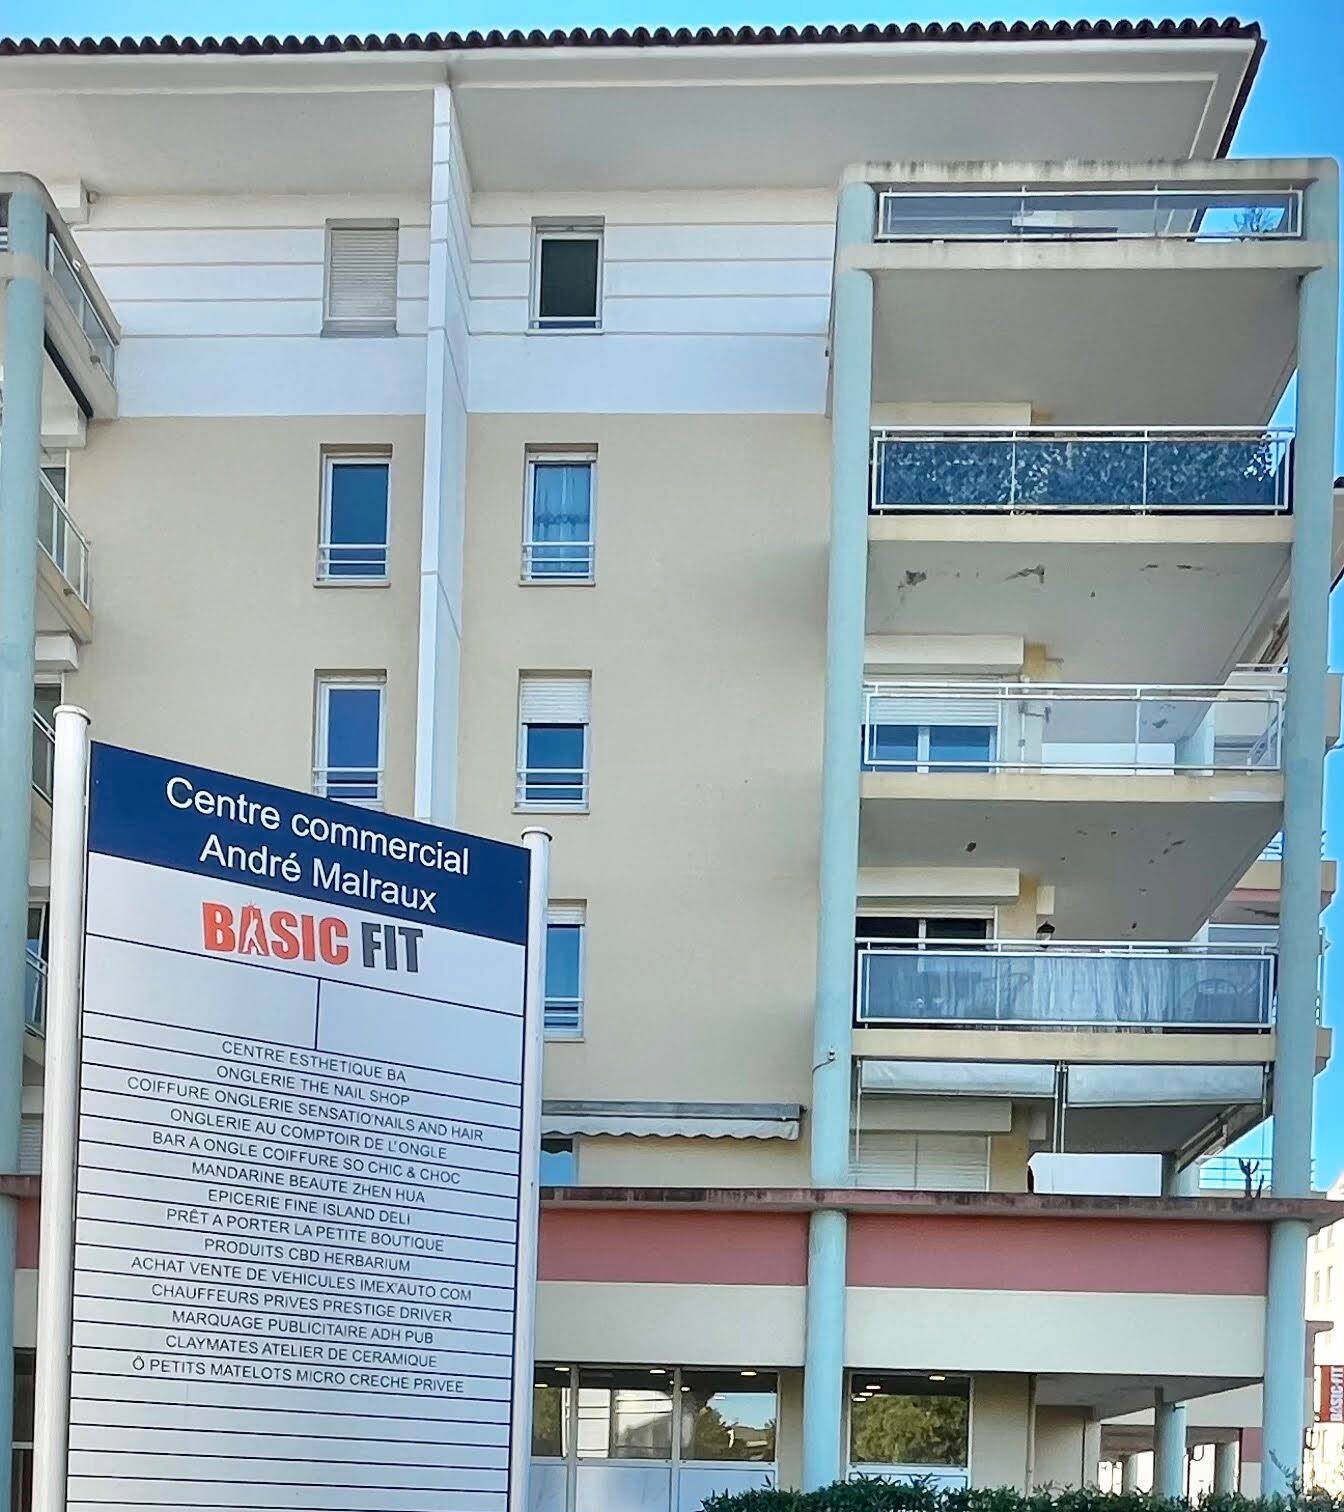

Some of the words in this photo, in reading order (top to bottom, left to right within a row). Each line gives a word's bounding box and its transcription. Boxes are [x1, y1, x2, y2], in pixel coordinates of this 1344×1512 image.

[166, 776, 280, 830] Centre
[292, 813, 470, 875] commercial
[199, 834, 302, 882] André
[312, 859, 437, 913] Malraux
[202, 902, 349, 966] BASIC
[361, 921, 424, 974] FIT
[221, 1040, 285, 1063] CENTRE
[289, 1052, 382, 1079] ESTHETIQUE
[387, 1068, 406, 1083] BA
[216, 1065, 295, 1089] ONGLERIE
[299, 1078, 329, 1095] THE
[333, 1083, 365, 1100] NAIL
[369, 1089, 409, 1106] SHOP
[170, 1108, 251, 1132] ONGLERIE
[254, 1120, 276, 1135] AU
[280, 1124, 360, 1147] COMPTOIR
[363, 1136, 384, 1150] DE
[208, 1188, 280, 1209] EPICERIE
[284, 1198, 318, 1214] FINE
[322, 1202, 375, 1220] ISLAND
[378, 1209, 410, 1225] DELI
[204, 1237, 284, 1258] PRODUITS
[288, 1247, 319, 1262] CBD
[324, 1251, 410, 1271] HERBARIUM
[151, 1283, 259, 1305] CHAUFFEURS
[263, 1293, 318, 1311] PRIVES
[323, 1299, 395, 1317] PRESTIGE
[399, 1306, 451, 1323] DRIVER
[172, 1310, 263, 1330] MARQUAGE
[268, 1318, 367, 1339] PUBLICITAIRE
[370, 1327, 400, 1341] ADH
[405, 1330, 433, 1344] PUB
[165, 1334, 258, 1354] CLAYMATES
[261, 1342, 323, 1358] ATELIER
[328, 1347, 347, 1361] DE
[352, 1349, 437, 1367] CERAMIQUE
[149, 1358, 205, 1375] PETITS
[210, 1363, 292, 1381] MATELOTS
[296, 1369, 345, 1385] MICRO
[349, 1373, 409, 1389] CRECHE
[413, 1377, 464, 1393] PRIVEE
